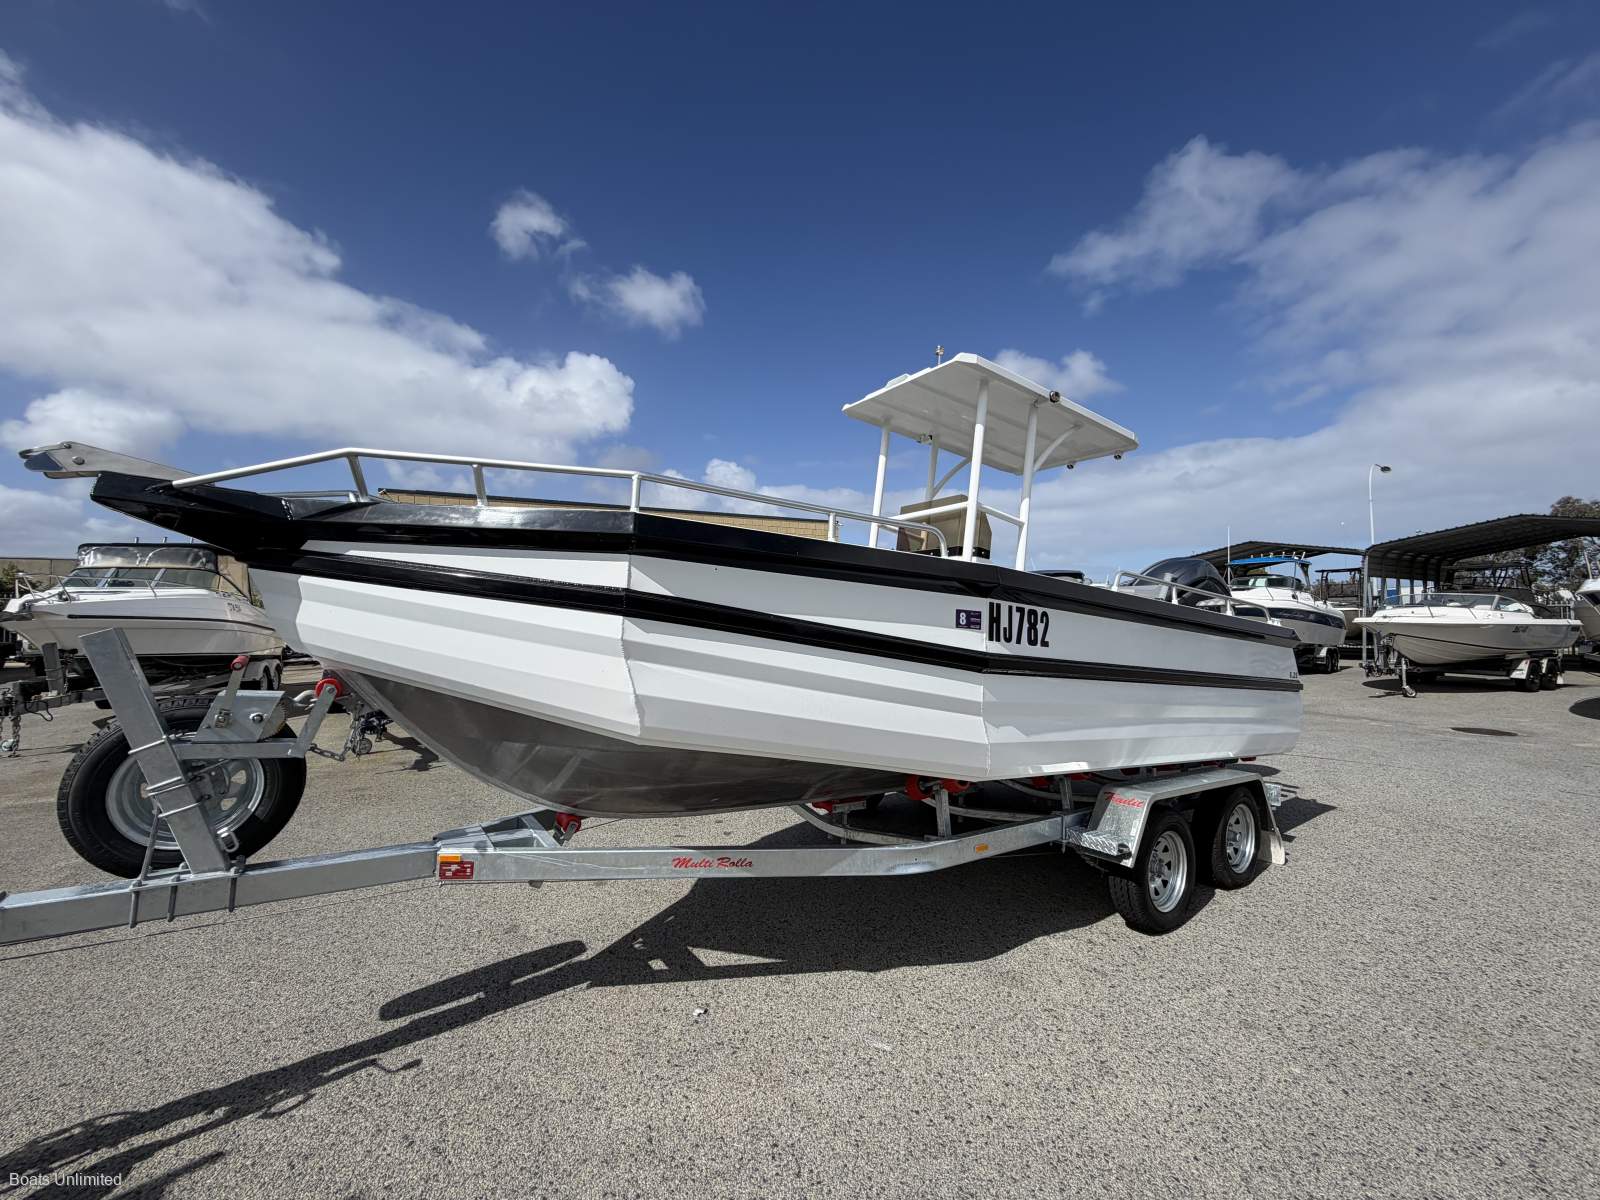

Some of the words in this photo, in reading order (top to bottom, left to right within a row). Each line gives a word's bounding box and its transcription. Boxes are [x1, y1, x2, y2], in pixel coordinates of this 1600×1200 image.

[959, 612, 967, 625] 8
[988, 601, 1050, 648] HJ782
[672, 856, 713, 869] Multi
[716, 856, 753, 869] Rolla
